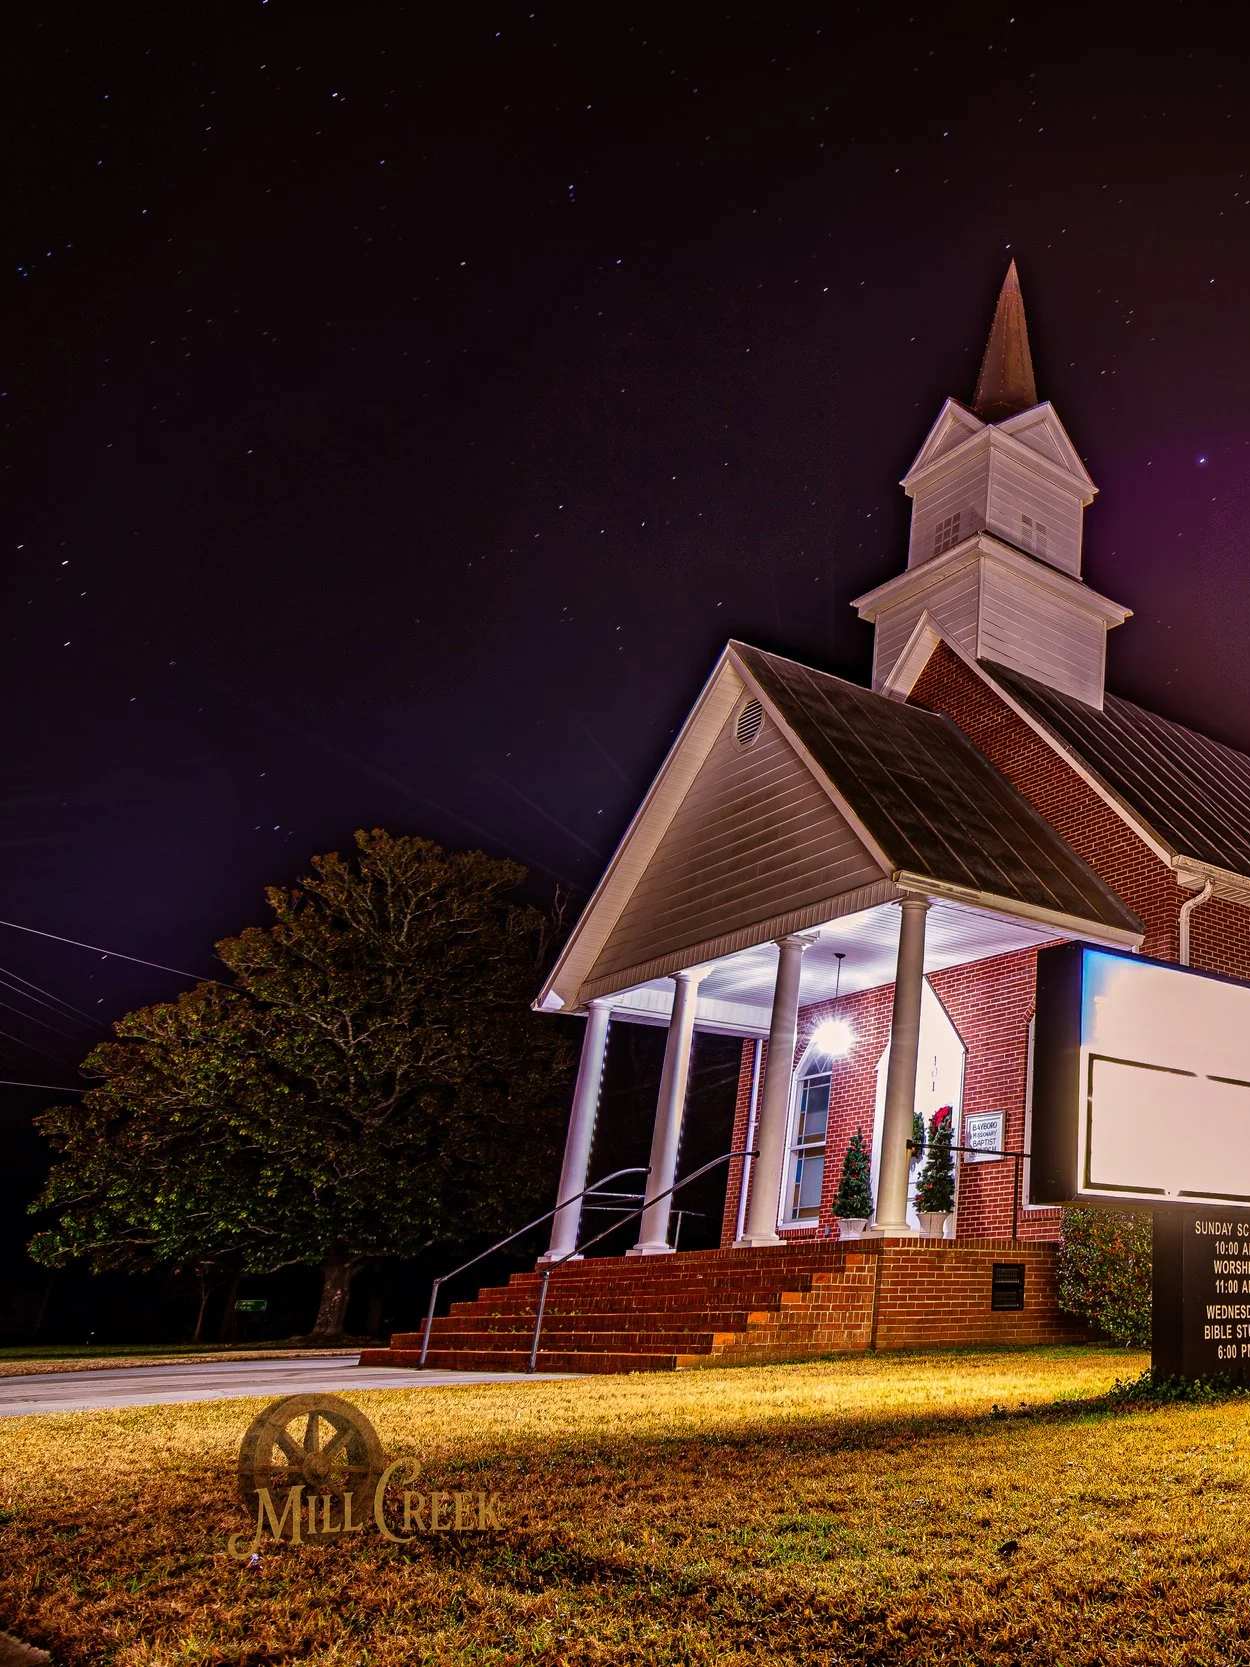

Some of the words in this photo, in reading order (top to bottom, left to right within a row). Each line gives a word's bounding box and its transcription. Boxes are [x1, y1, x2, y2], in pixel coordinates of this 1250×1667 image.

[972, 1121, 998, 1132] BAYBORO
[972, 1130, 998, 1139] MISSIONARY
[972, 1138, 997, 1148] BAPTIST
[1195, 1220, 1233, 1236] SUNDAY
[1215, 1241, 1239, 1255] 10:00
[1215, 1280, 1239, 1294] 11:00
[1204, 1325, 1232, 1340] BIBLE
[1217, 1345, 1237, 1359] 6:00
